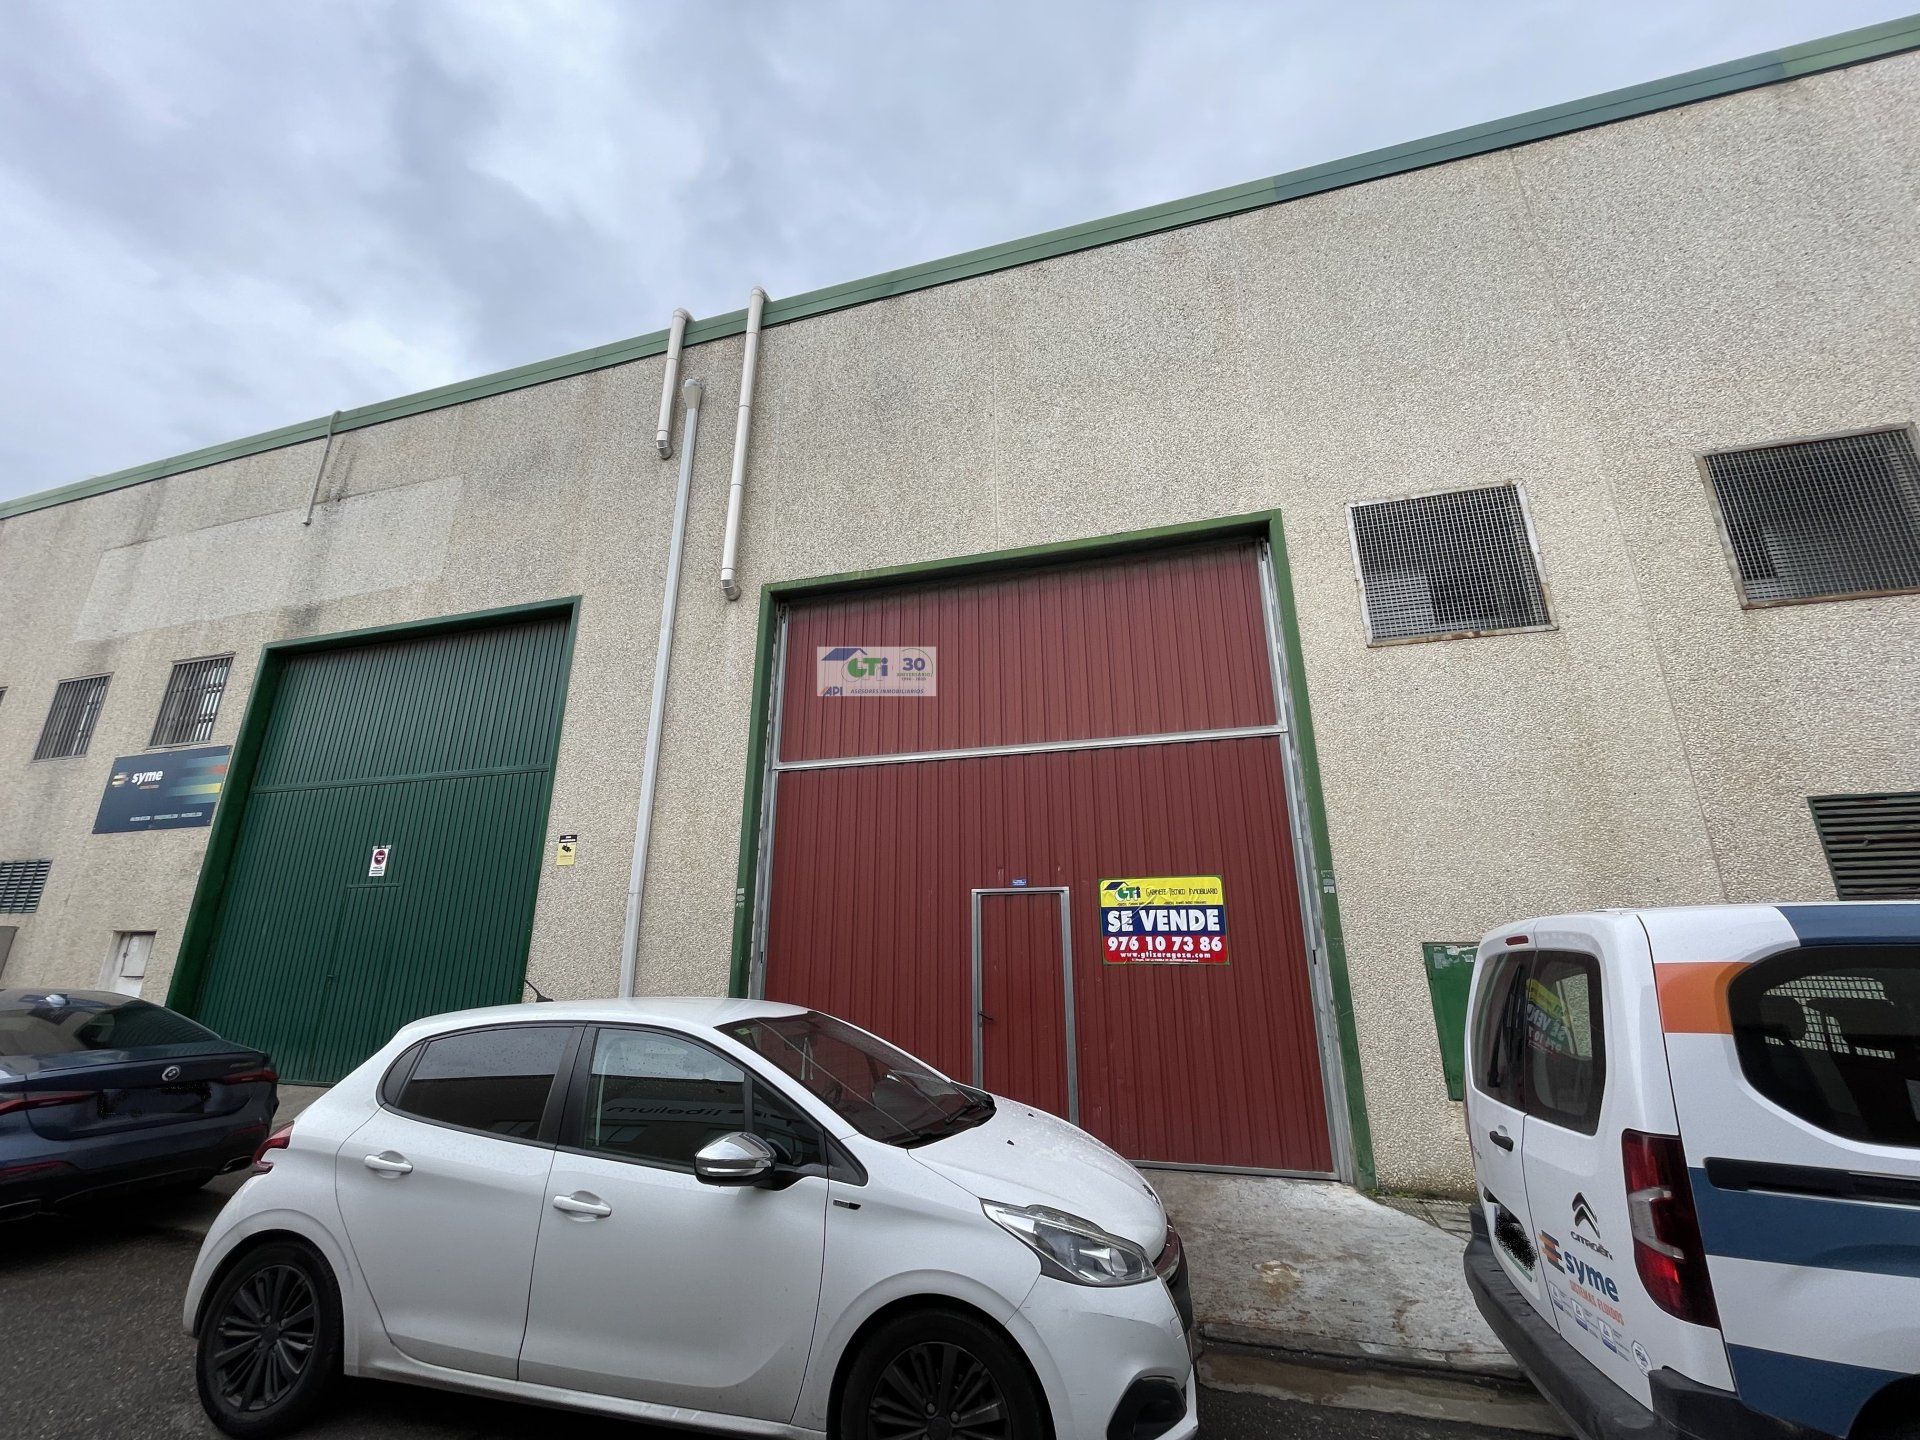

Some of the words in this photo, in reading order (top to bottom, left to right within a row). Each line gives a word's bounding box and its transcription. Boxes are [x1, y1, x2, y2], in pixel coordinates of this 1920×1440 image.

[131, 770, 163, 785] syme
[1107, 910, 1134, 932] SE
[1139, 908, 1221, 932] VENDE
[1107, 936, 1139, 951] 976
[1145, 936, 1166, 951] 10
[1171, 936, 1194, 951] 73
[1199, 936, 1222, 951] 86
[1564, 1251, 1619, 1302] syme
